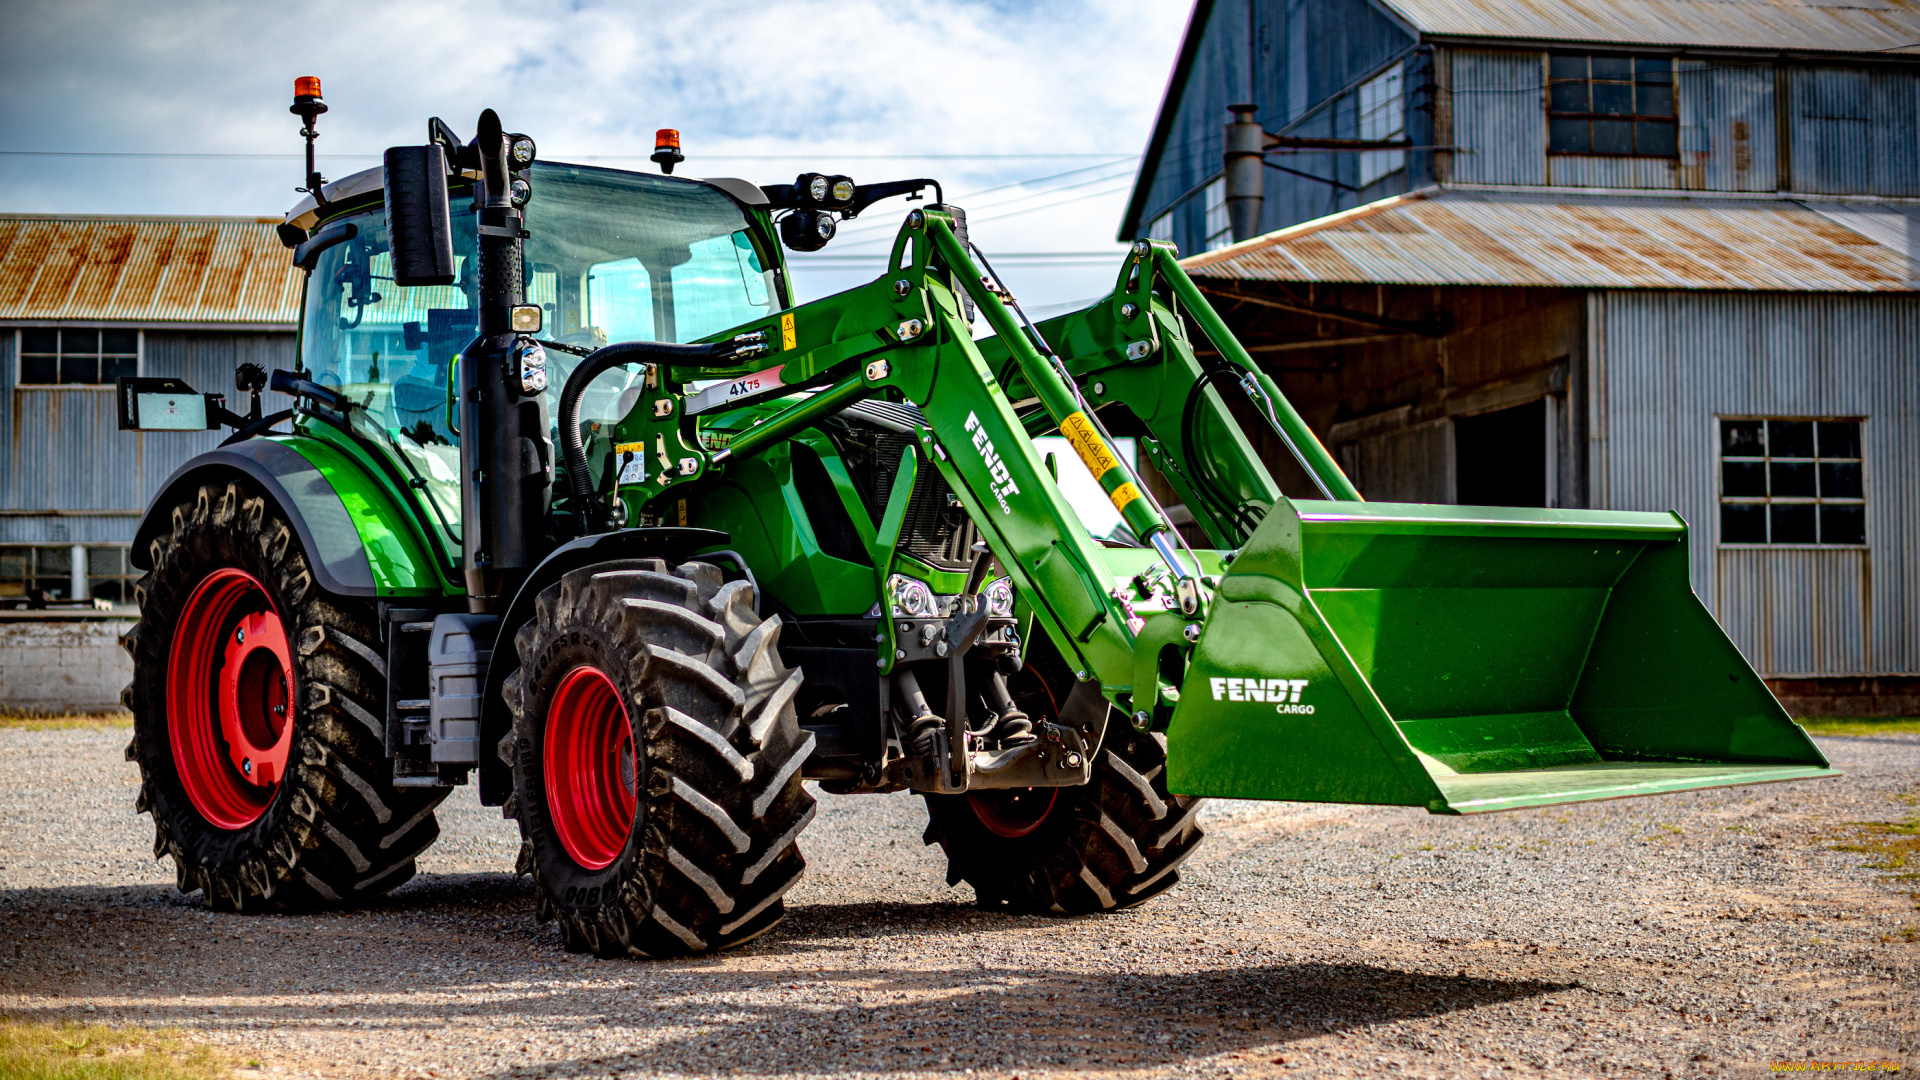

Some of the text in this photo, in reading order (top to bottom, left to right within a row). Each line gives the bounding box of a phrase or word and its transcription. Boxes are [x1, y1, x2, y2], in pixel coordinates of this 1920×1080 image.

[964, 410, 1020, 497] FENDT
[990, 481, 1011, 515] CARGO
[1209, 677, 1309, 703] FENDT
[1276, 704, 1316, 715] CARGO
